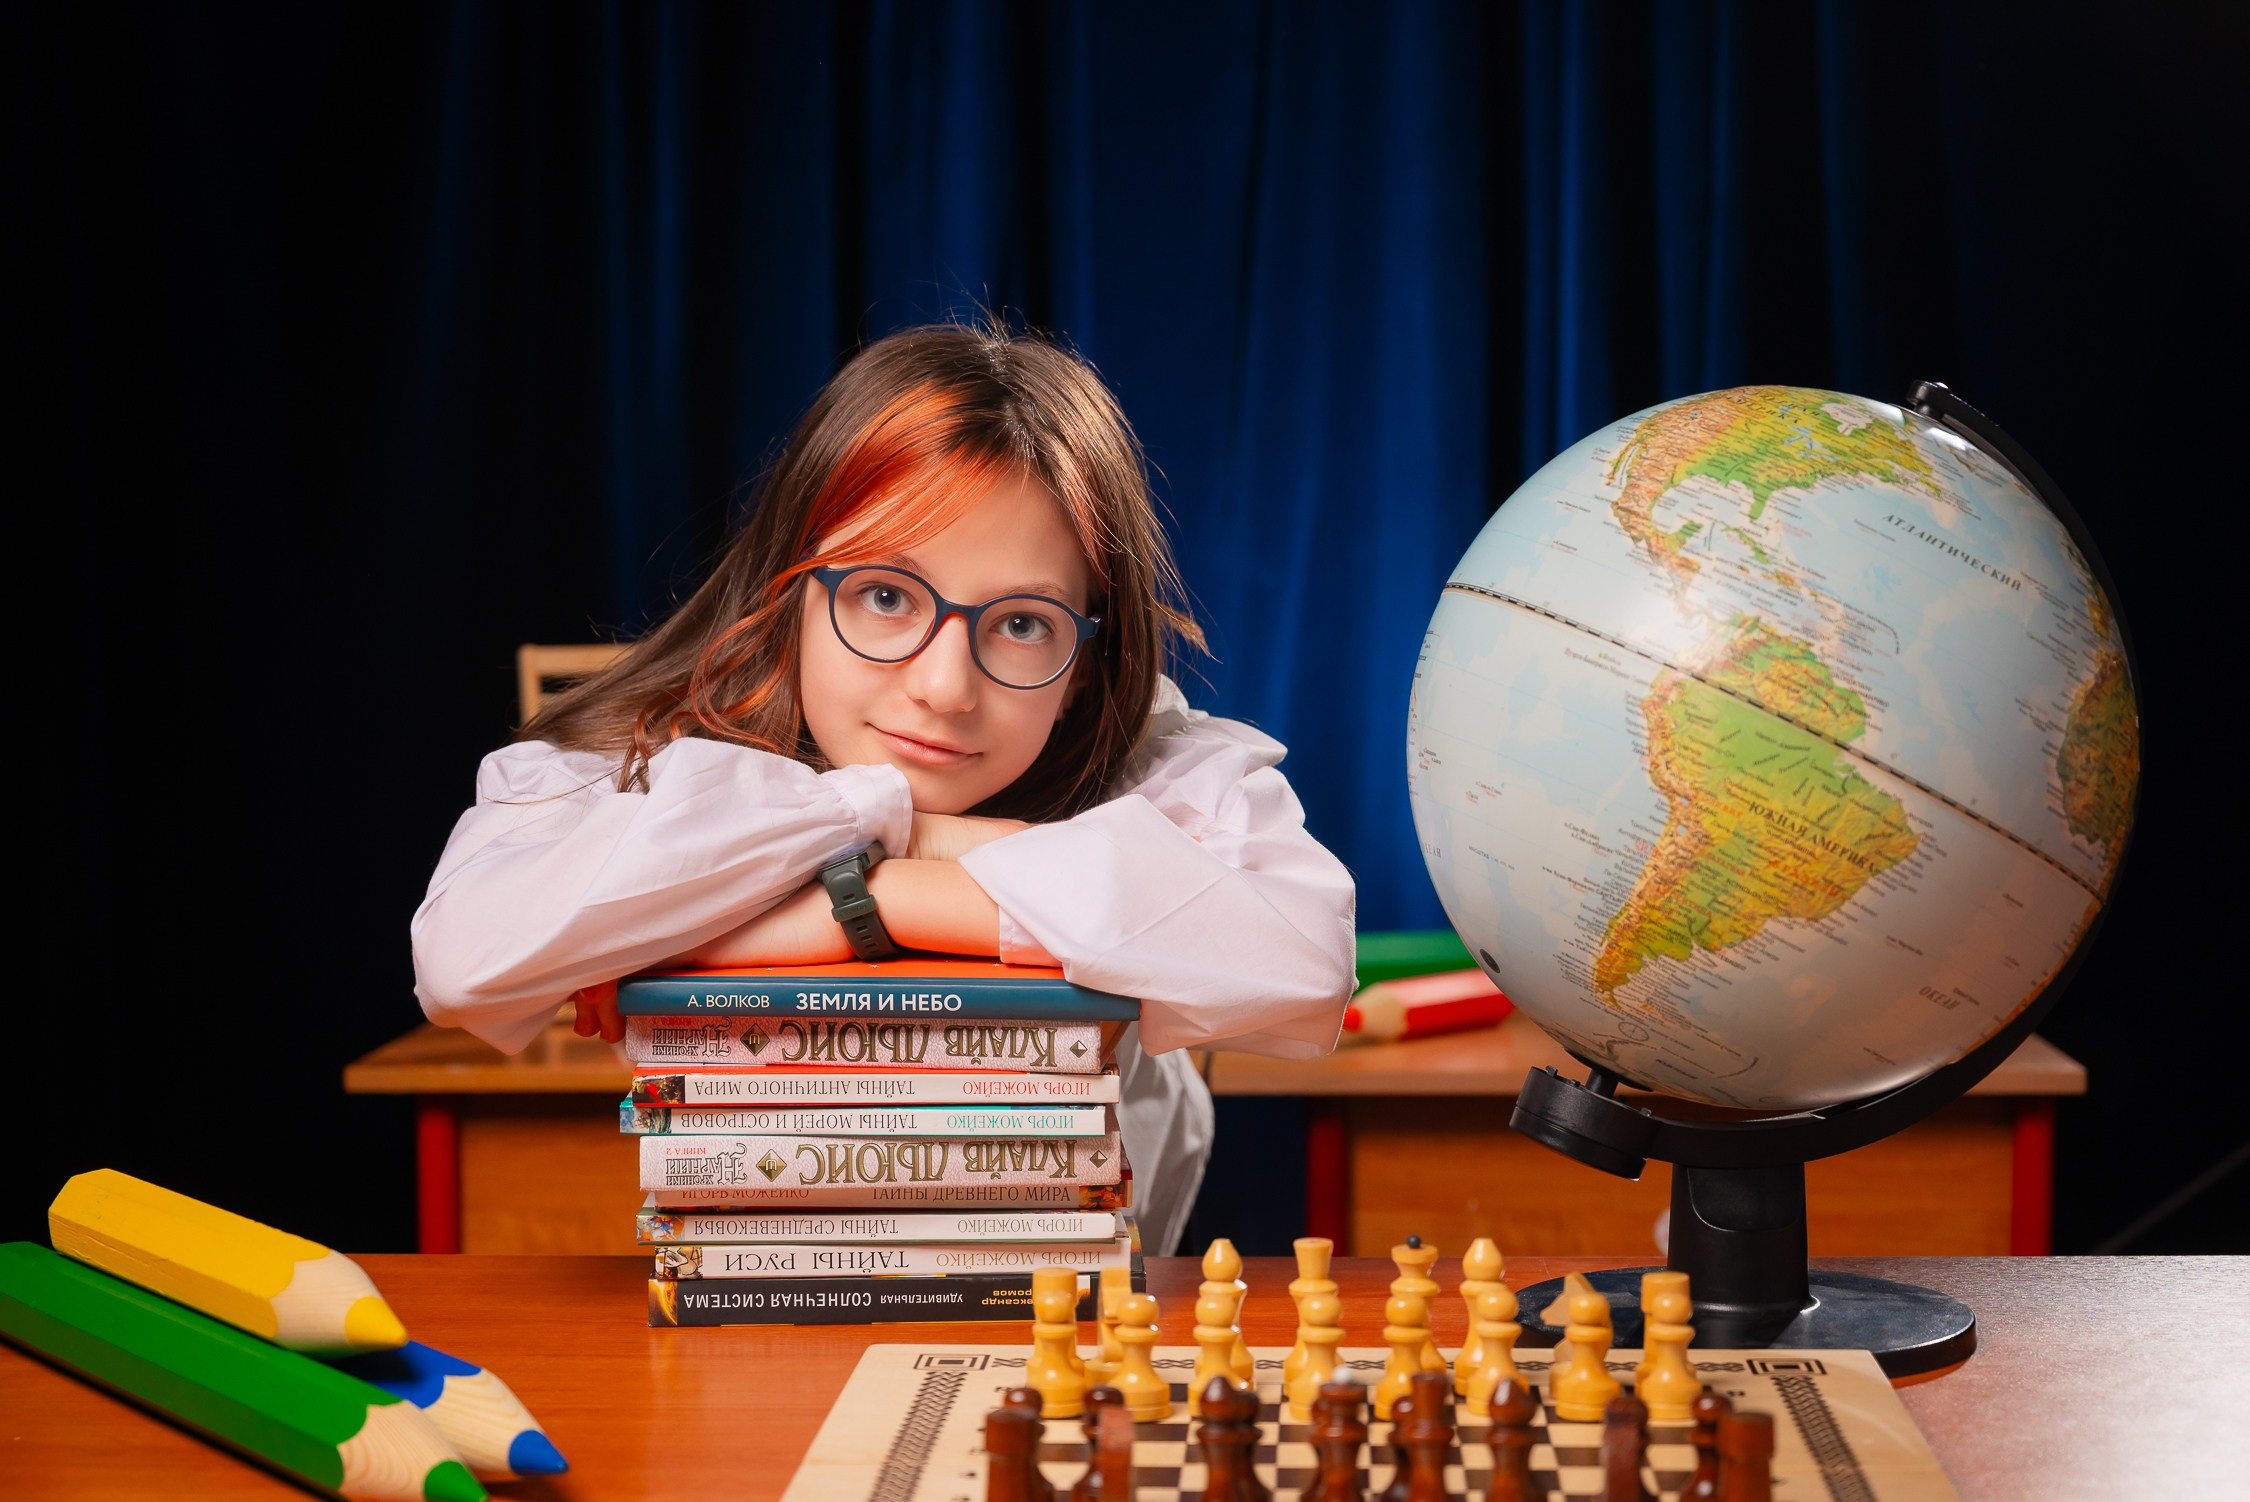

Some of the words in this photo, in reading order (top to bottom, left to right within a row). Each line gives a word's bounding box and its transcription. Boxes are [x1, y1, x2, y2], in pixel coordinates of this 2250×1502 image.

[1882, 514, 2022, 591] АТЛАНТИЧЕСКИЙ
[1748, 801, 1808, 838] ЮЖНАЯ
[1808, 834, 1874, 873] АМЕРИКА
[687, 994, 703, 1008] А.
[706, 994, 770, 1009] ВОЛКОВ
[796, 992, 871, 1011] ЗЕМЛЯ
[878, 993, 894, 1011] И
[902, 994, 962, 1012] НЕБО
[1919, 986, 1960, 1010] ОКЕАН
[660, 1017, 692, 1026] КНИГА
[652, 1017, 733, 1057] НАРНИИ
[778, 1019, 930, 1064] ЛЬЮИС
[652, 1045, 698, 1056] ХРОНИКИ
[943, 1024, 1058, 1068] КЛАЙВ
[694, 1081, 742, 1095] МИРА
[747, 1080, 850, 1095] АНТИЧНОГО
[856, 1080, 915, 1098] ТАЙНЫ
[962, 1081, 1040, 1098] МОЖЕЙКО
[1044, 1081, 1090, 1095] ИГОРЬ
[680, 1113, 770, 1129] ОСТРОВОВ
[776, 1114, 786, 1129] И
[793, 1114, 853, 1132] МОРЕЙ
[859, 1114, 917, 1132] ТАЙНЫ
[947, 1115, 1024, 1132] МОЖЕЙКО
[1028, 1115, 1074, 1129] ИГОРЬ
[665, 1147, 672, 1155] 2
[675, 1147, 707, 1155] КНИГА
[666, 1143, 748, 1184] НАРНИИ
[795, 1141, 949, 1184] ЛЬЮИС
[962, 1139, 1077, 1180] КЛАЙВ
[666, 1175, 714, 1186] ХРОНИКИ
[682, 1189, 728, 1199] ИГОРЬ
[732, 1189, 809, 1199] МОЖЕЙКО
[872, 1188, 928, 1201] ТАЙНЫ
[933, 1186, 1019, 1202] ДРЕВНЕГО
[1025, 1186, 1071, 1201] МИРА
[694, 1219, 835, 1235] СРЕДНЕВЕКОВЬЯ
[840, 1219, 899, 1238] ТАЙНЫ
[957, 1219, 1034, 1236] МОЖЕЙКО
[1038, 1219, 1083, 1232] ИГОРЬ
[725, 1252, 796, 1271] РУСИ
[812, 1251, 909, 1273] ТАЙНЫ
[936, 1252, 1036, 1269] МОЖЕЙКО
[1041, 1251, 1100, 1265] ИГОРЬ
[770, 1292, 872, 1308] СОЛНЕЧНАЯ
[880, 1293, 963, 1305] УДИВИТЕЛЬНАЯ
[992, 1288, 1032, 1297] ромов
[683, 1293, 764, 1309] СИСТЕМА
[981, 1298, 1034, 1306] ександр
